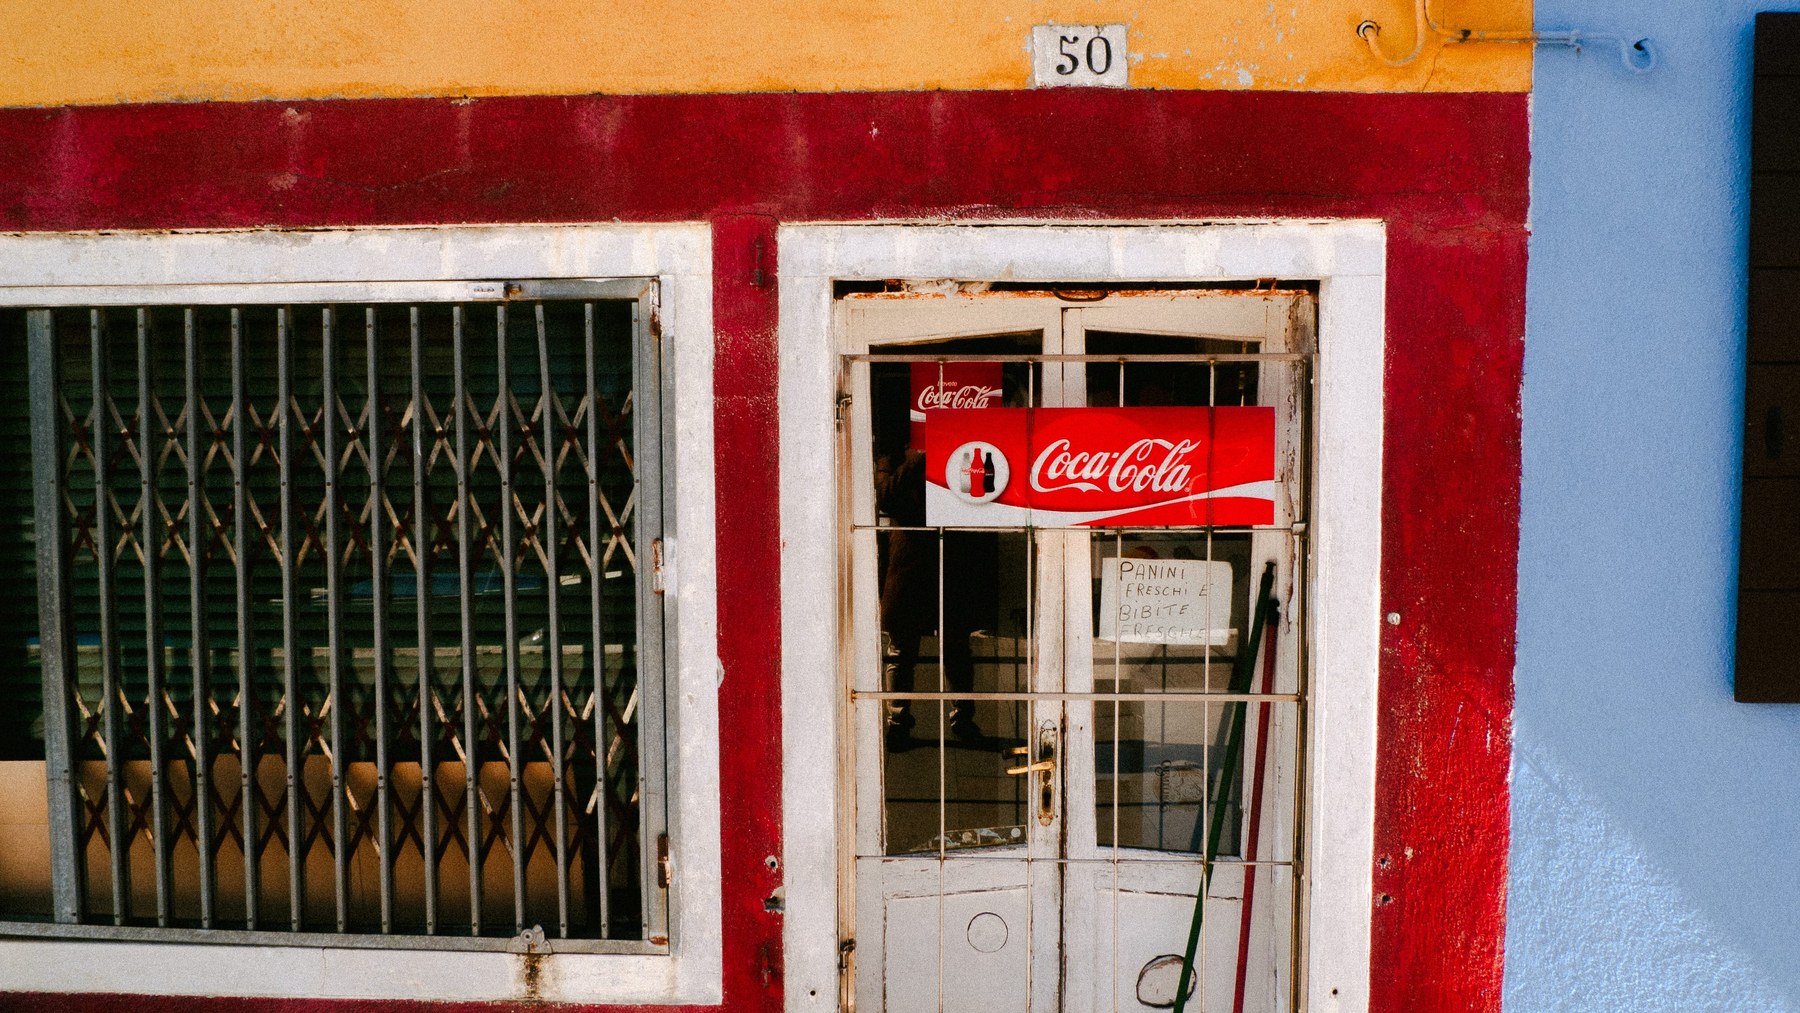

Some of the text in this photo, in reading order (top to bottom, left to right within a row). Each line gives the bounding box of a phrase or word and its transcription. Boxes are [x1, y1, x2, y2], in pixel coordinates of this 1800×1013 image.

[1056, 35, 1112, 75] 50
[918, 385, 991, 410] Coca-Cola
[1030, 438, 1201, 493] Coca-Cola
[1120, 561, 1185, 581] PANINI
[1199, 583, 1214, 597] E
[1119, 600, 1190, 621] BIBITE
